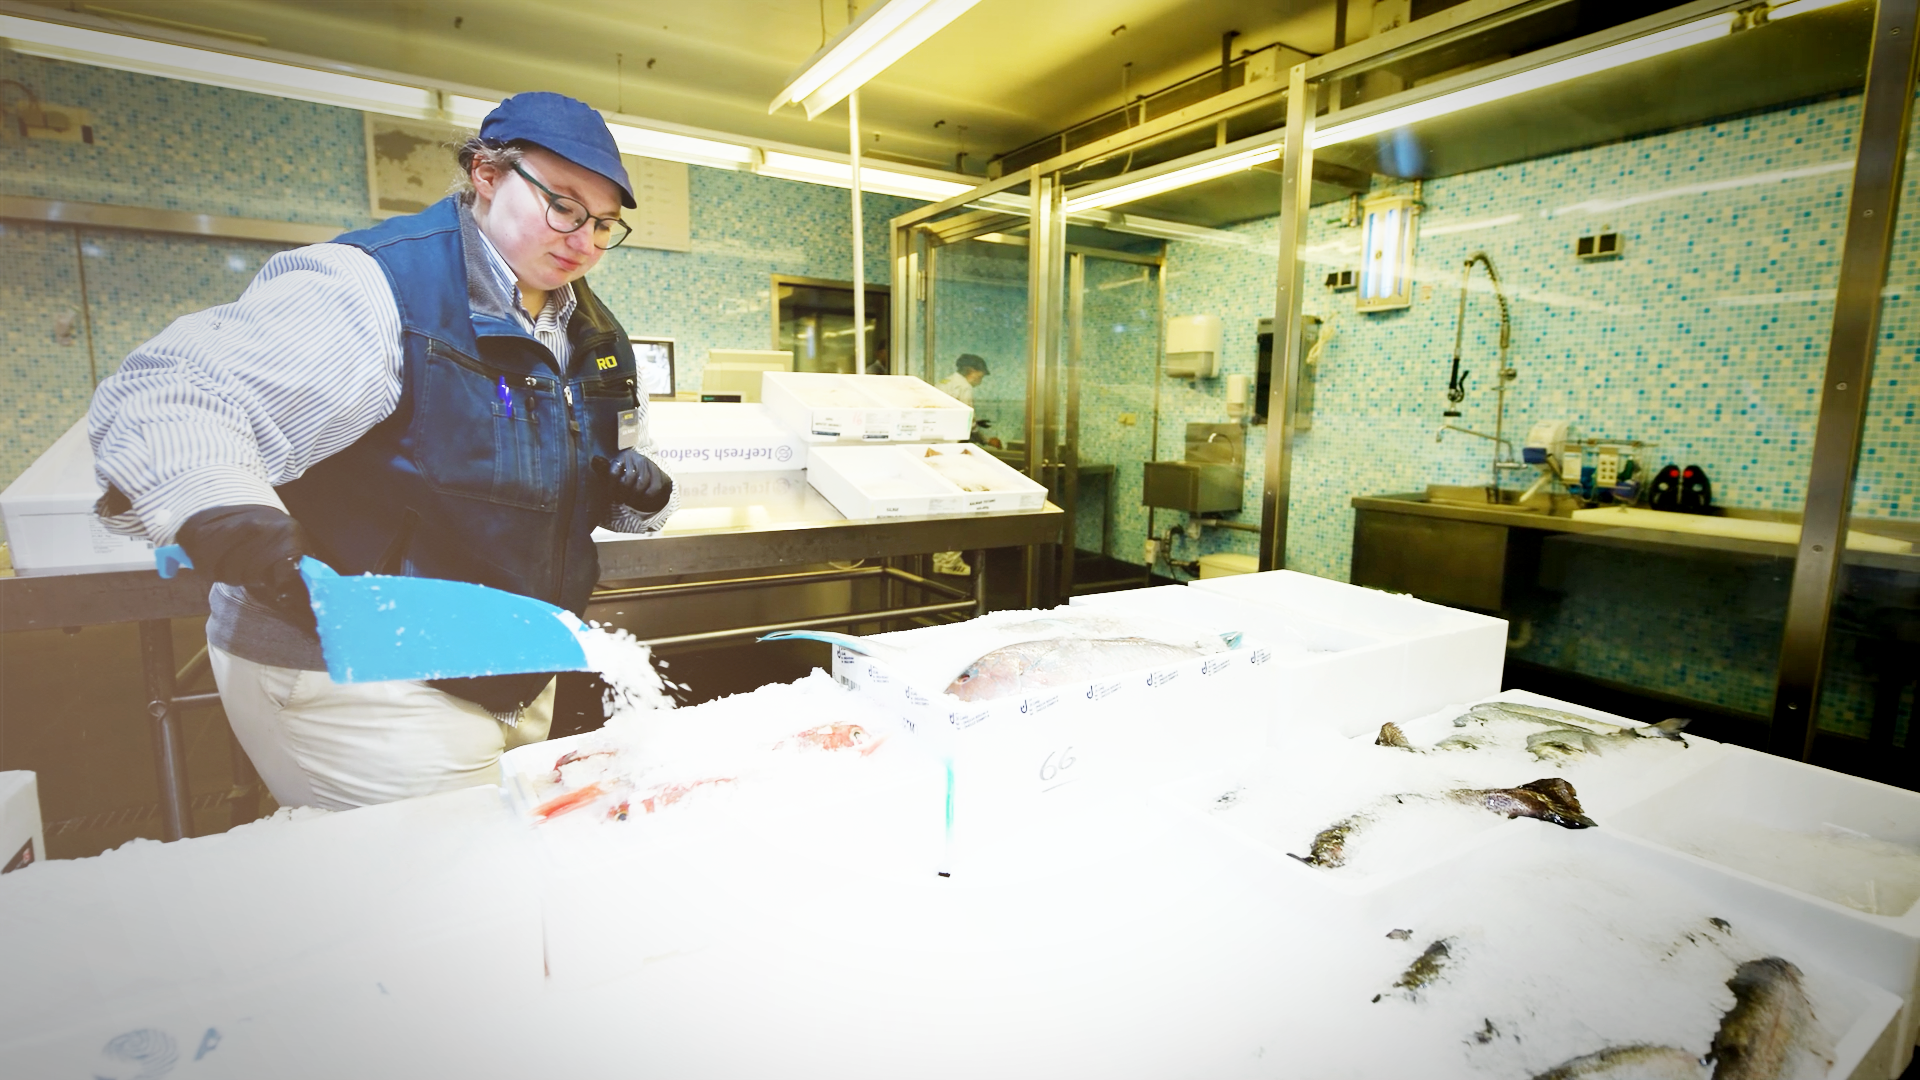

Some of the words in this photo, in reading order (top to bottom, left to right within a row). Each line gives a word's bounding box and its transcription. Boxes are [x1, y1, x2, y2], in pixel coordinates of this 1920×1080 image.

[596, 355, 618, 371] RO
[656, 448, 710, 462] Seafoo
[714, 447, 773, 461] IceFresh
[1039, 746, 1077, 780] 66
